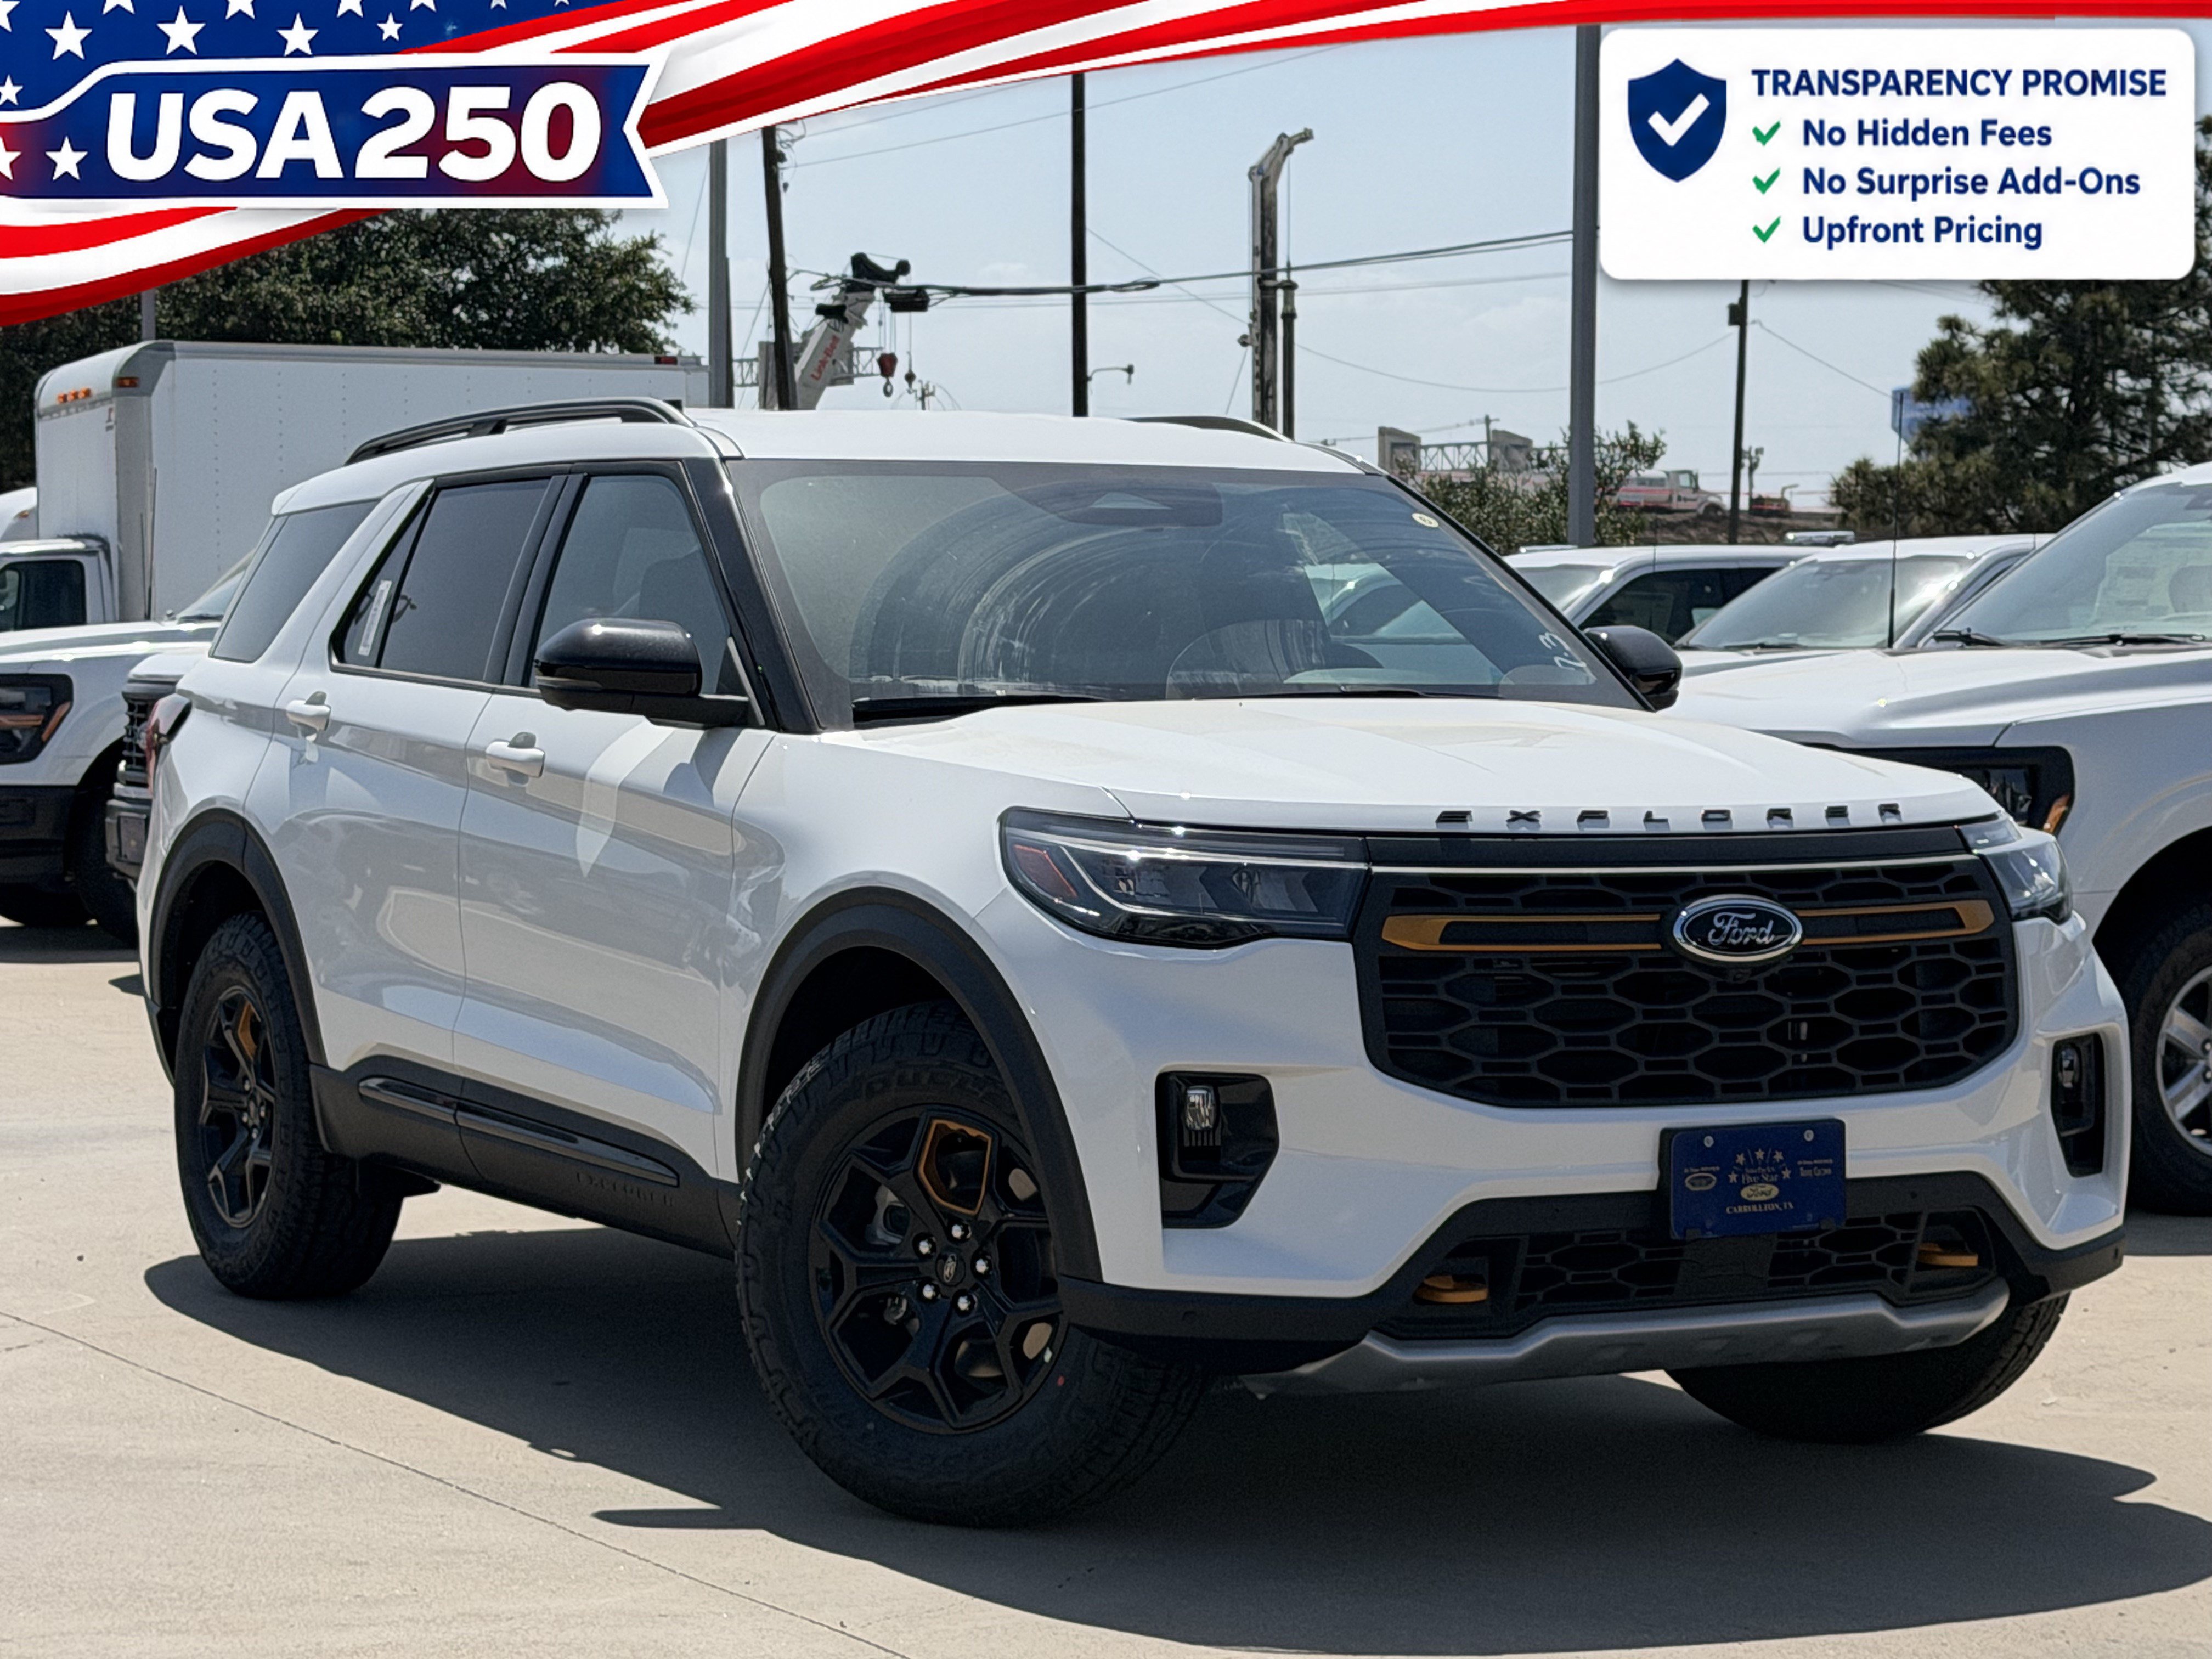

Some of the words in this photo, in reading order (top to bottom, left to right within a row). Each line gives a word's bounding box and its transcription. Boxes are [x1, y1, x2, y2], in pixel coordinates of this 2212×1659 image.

[1435, 803, 1901, 825] EXPLORER
[1707, 911, 1775, 946] Ford
[1746, 1185, 1775, 1198] Ford
